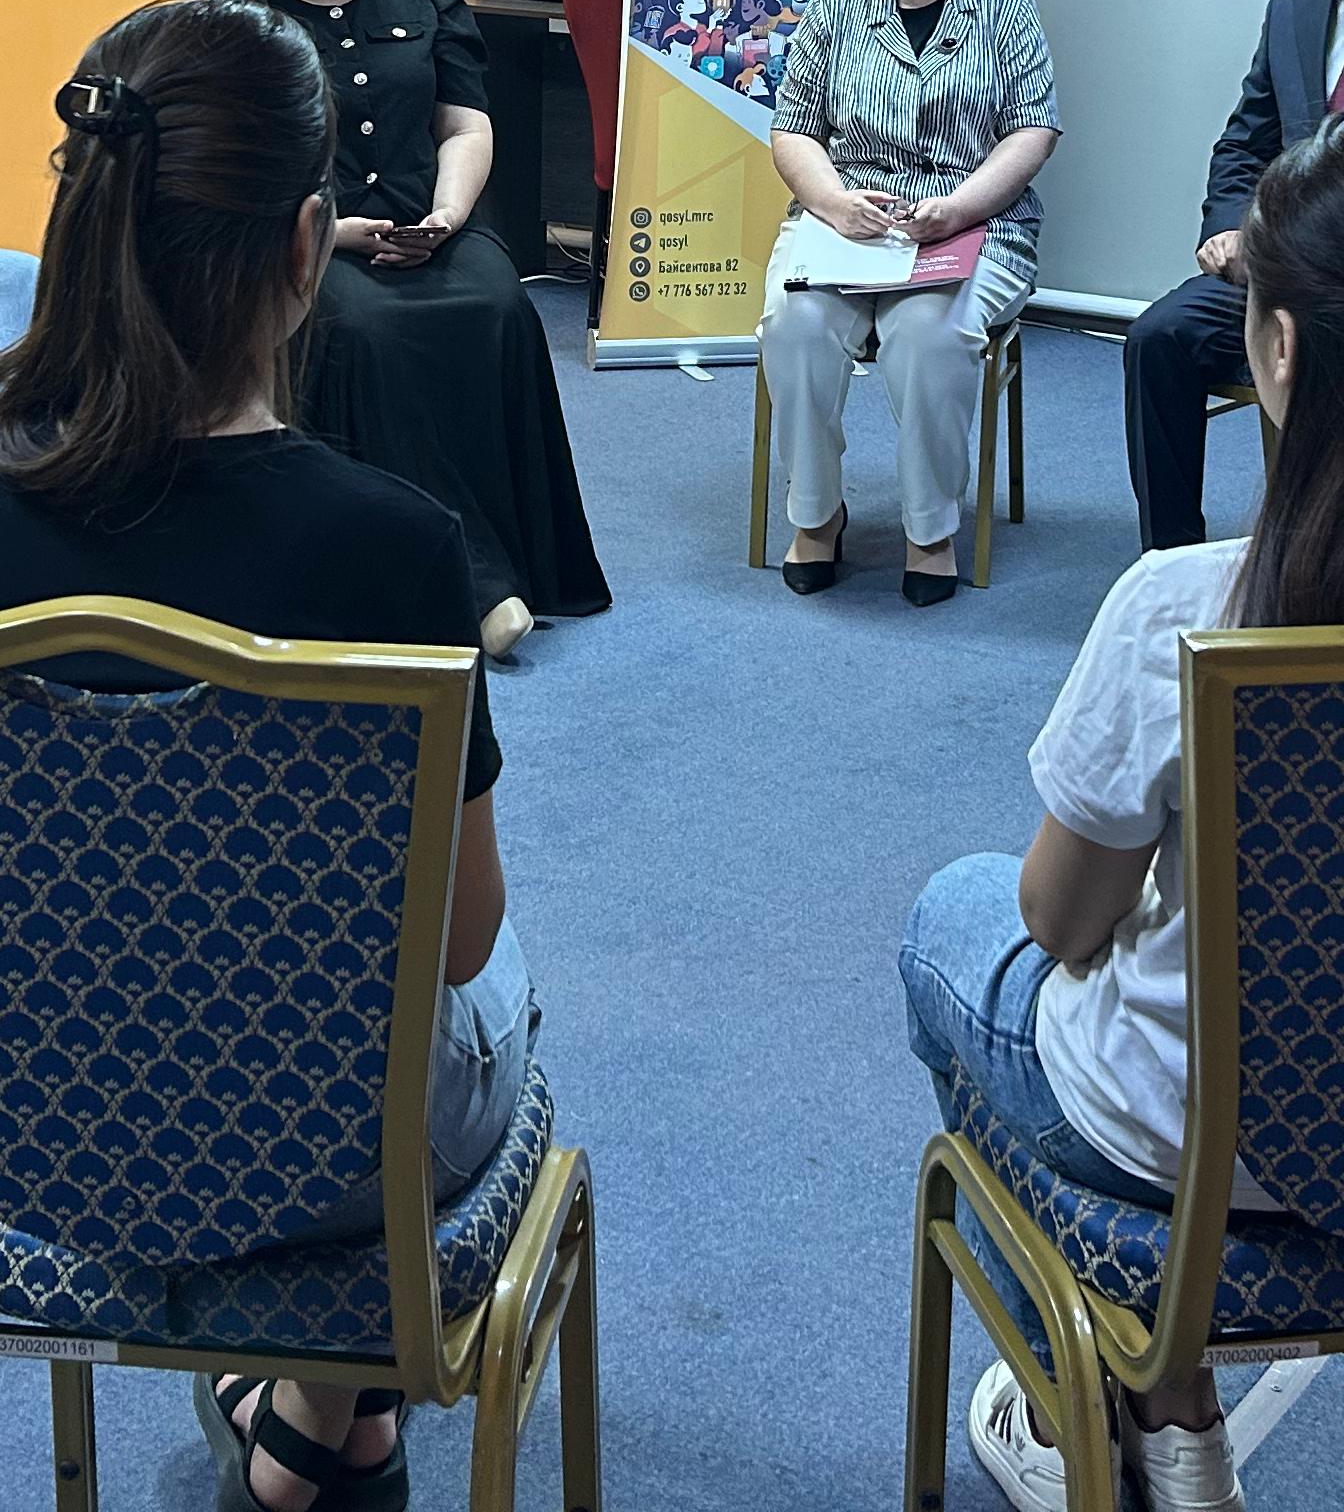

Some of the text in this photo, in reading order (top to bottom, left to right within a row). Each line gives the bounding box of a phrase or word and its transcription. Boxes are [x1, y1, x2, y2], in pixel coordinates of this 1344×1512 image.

[659, 234, 688, 250] qosyl
[725, 259, 739, 272] 82
[657, 282, 747, 297] +7 776 567 32 32
